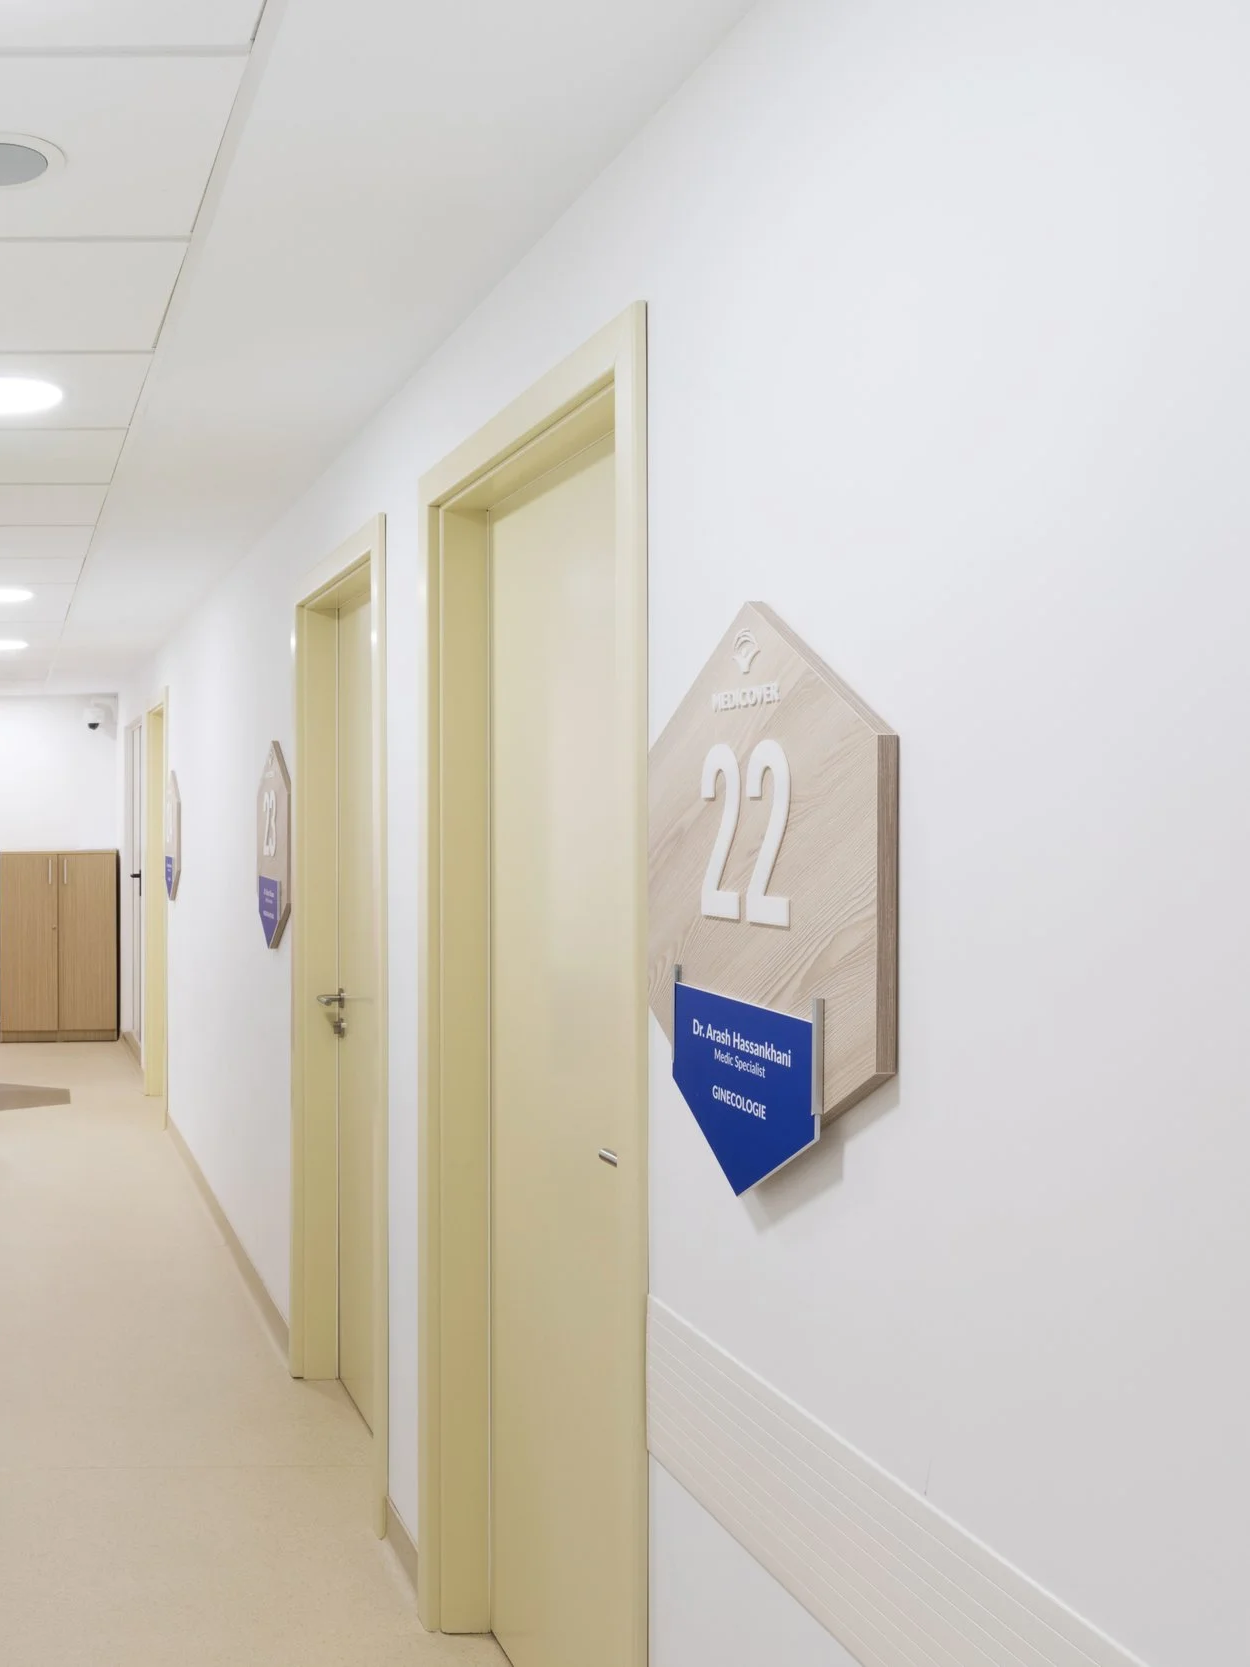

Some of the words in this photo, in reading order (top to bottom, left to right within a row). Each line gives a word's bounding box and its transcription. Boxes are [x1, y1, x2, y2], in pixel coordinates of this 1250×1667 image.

[263, 789, 277, 857] 23
[700, 739, 791, 929] 22
[692, 1018, 705, 1038] Dr.
[706, 1023, 731, 1047] Arash
[732, 1031, 792, 1068] Hassankhani
[714, 1048, 734, 1067] Medic
[734, 1055, 766, 1079] Specialist
[712, 1085, 767, 1120] GINECOLOGIE
